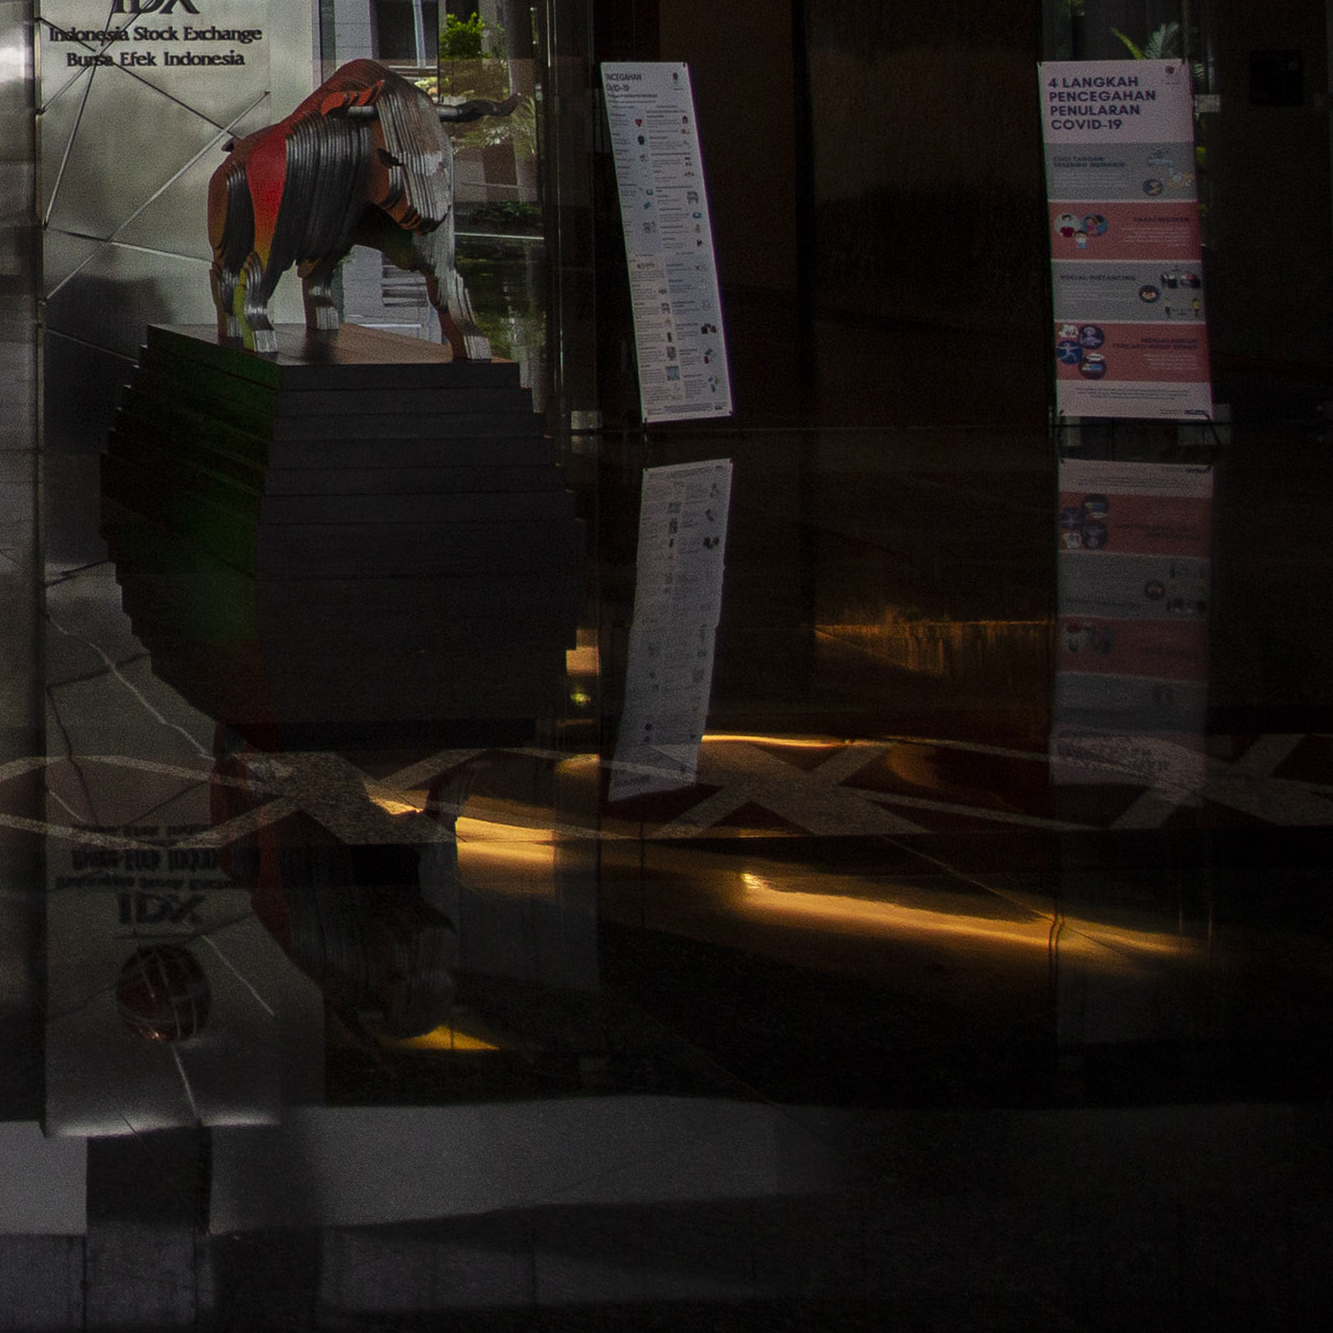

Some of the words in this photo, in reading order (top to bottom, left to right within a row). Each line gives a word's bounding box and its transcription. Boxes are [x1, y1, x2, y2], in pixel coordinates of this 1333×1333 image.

[49, 26, 129, 42] Indonesia
[133, 27, 178, 41] Stock
[183, 28, 262, 43] Exchange
[67, 53, 114, 67] Bursa
[120, 52, 155, 67] Efek
[164, 50, 245, 66] Indonesia
[1048, 77, 1058, 88] 4
[1062, 76, 1139, 88] LANGKAH
[1049, 89, 1156, 102] PENCEGAHAN
[1050, 104, 1140, 117] PENULARAN
[1051, 119, 1123, 131] COVID-19
